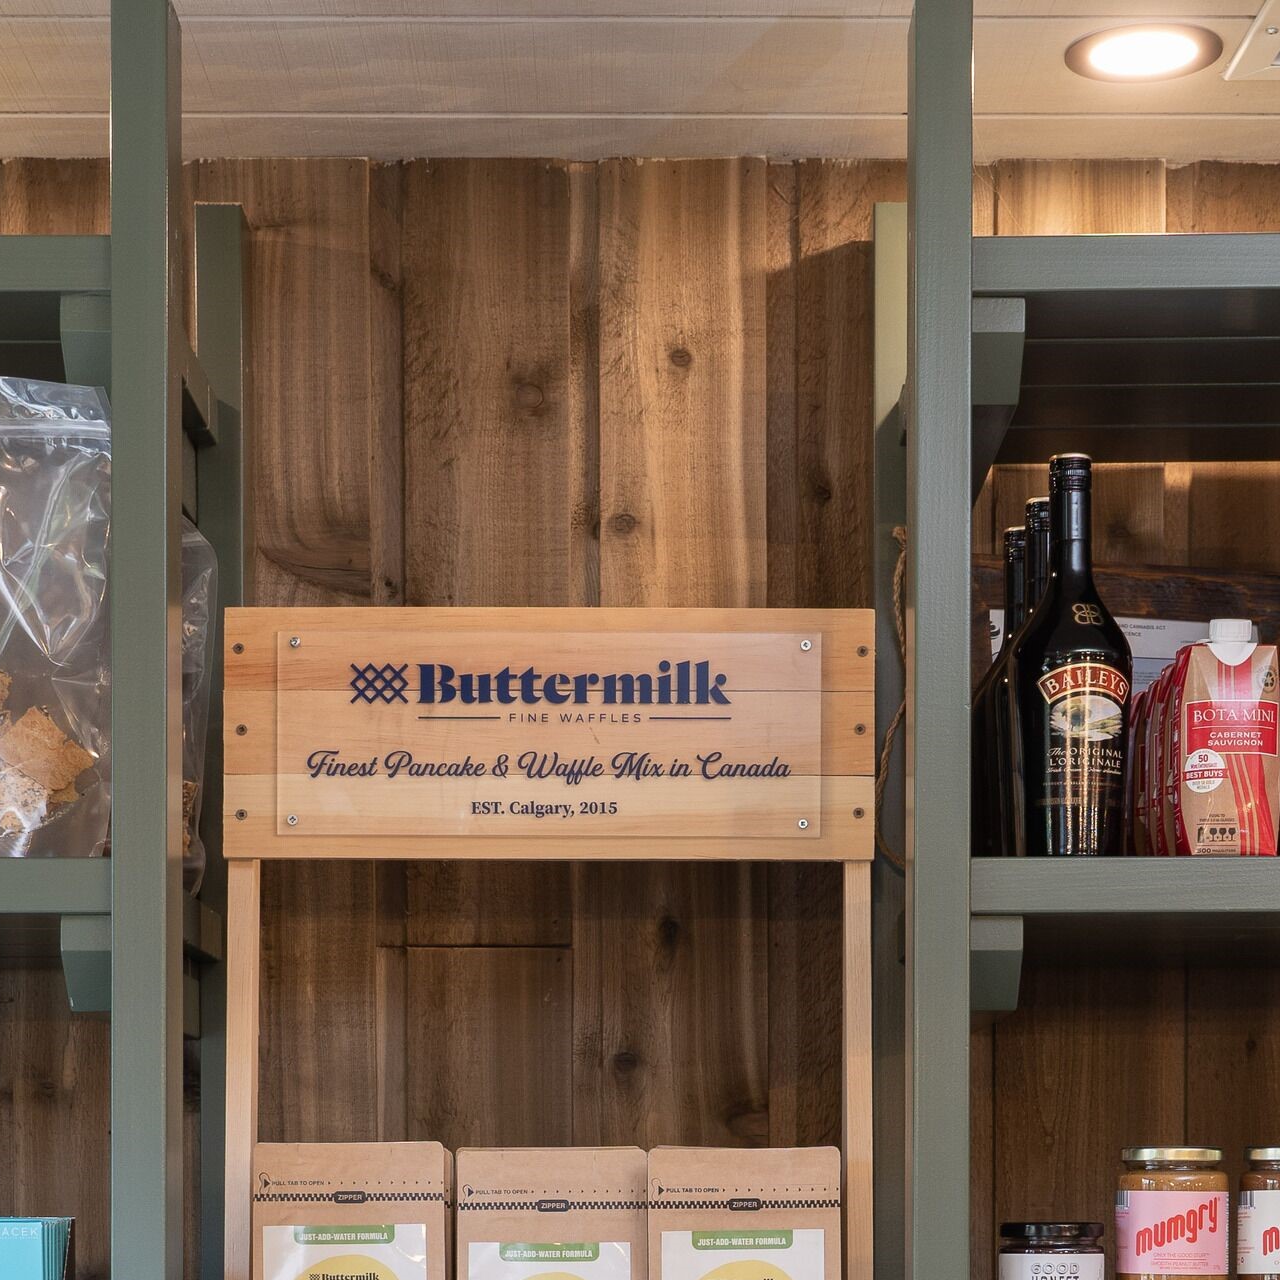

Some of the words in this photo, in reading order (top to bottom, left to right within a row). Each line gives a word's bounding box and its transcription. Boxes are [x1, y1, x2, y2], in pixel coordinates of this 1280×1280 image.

[418, 659, 732, 705] Buttermilk
[1045, 666, 1126, 697] BAILEYS
[509, 713, 549, 723] FINE
[559, 713, 642, 723] WAFFLES
[1193, 709, 1238, 723] BOTA
[1242, 708, 1275, 723] MINI
[307, 750, 377, 781] Finest
[384, 750, 485, 779] Pancake
[492, 754, 507, 778] &
[518, 751, 604, 784] Waffle
[611, 752, 664, 779] Mix
[670, 756, 692, 778] in
[698, 753, 790, 778] Canada
[471, 802, 504, 815] EST.
[509, 802, 574, 819] Calgary,
[579, 802, 618, 815] 2015
[1136, 1197, 1219, 1256] mumgry
[698, 1238, 753, 1246] JUST-ADD-WATER
[322, 1273, 379, 1280] Buttermilk
